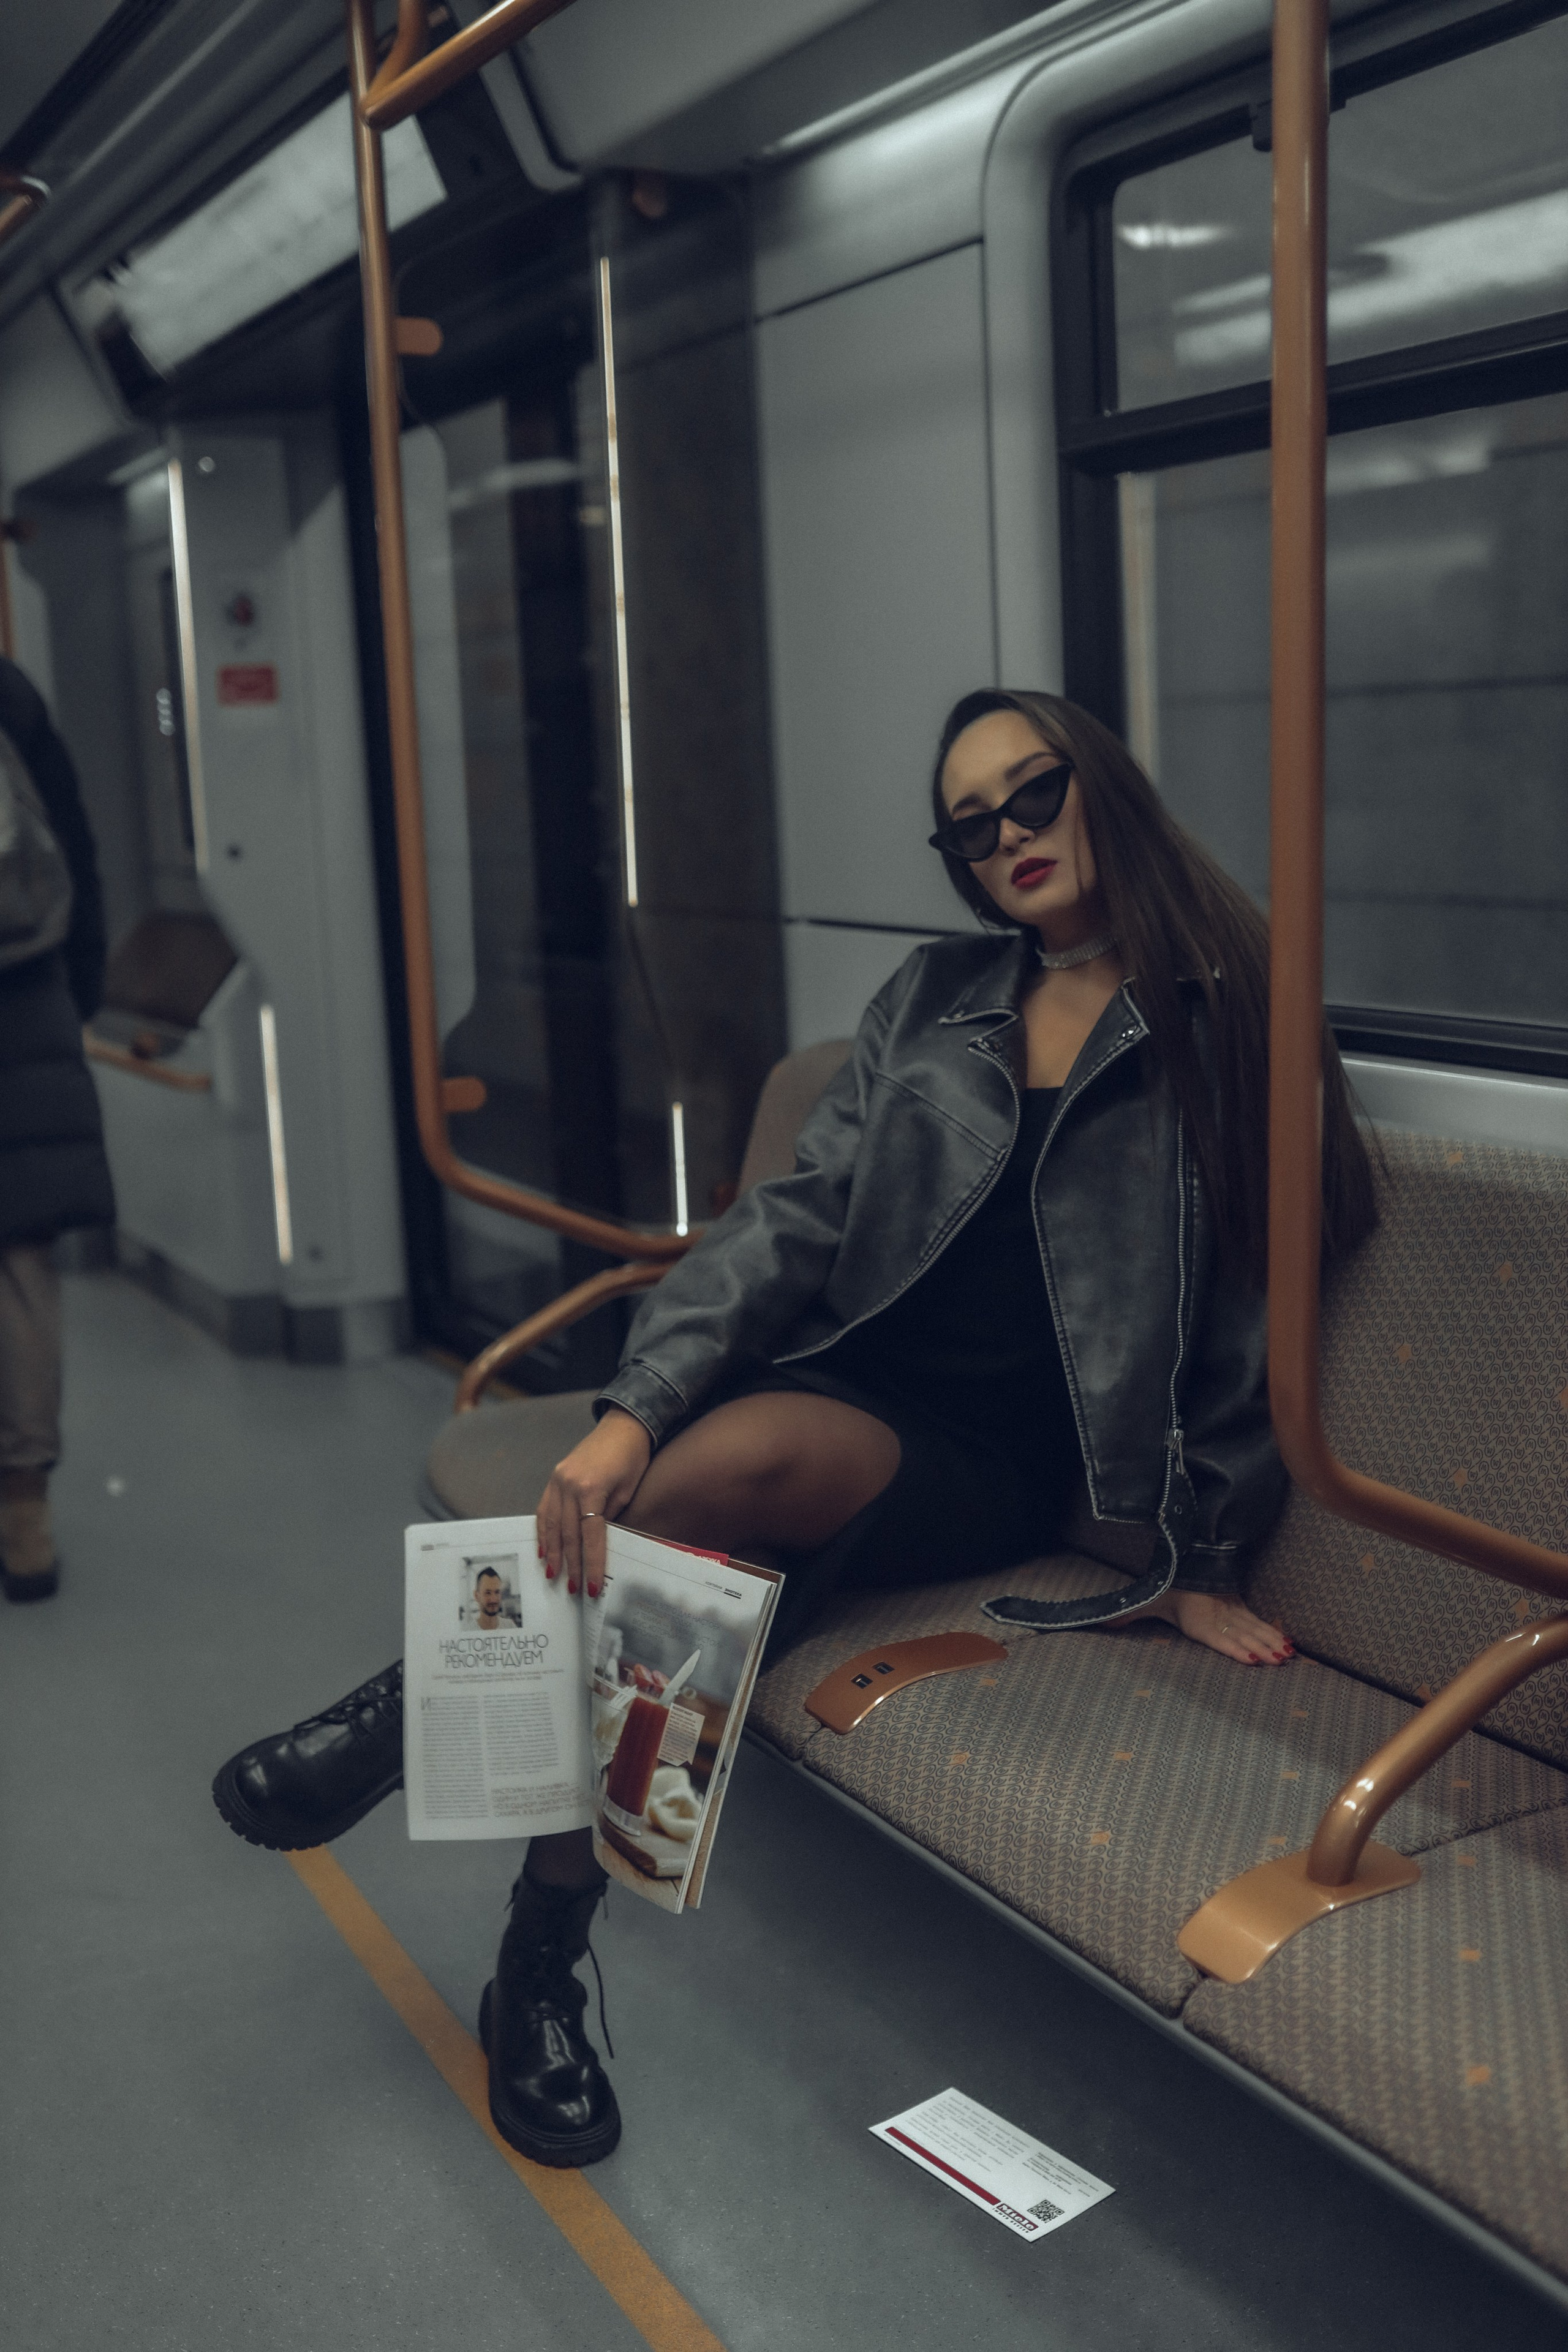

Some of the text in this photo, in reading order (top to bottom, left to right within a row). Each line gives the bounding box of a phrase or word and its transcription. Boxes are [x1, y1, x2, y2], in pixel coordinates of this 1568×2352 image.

[725, 1588, 742, 1597] ЭНОТЕКА
[439, 1634, 549, 1654] НАСТОЯТЕЛЬНО
[445, 1650, 543, 1668] РЕКОМЕНДУЕМ
[998, 2205, 1035, 2230] Miele
